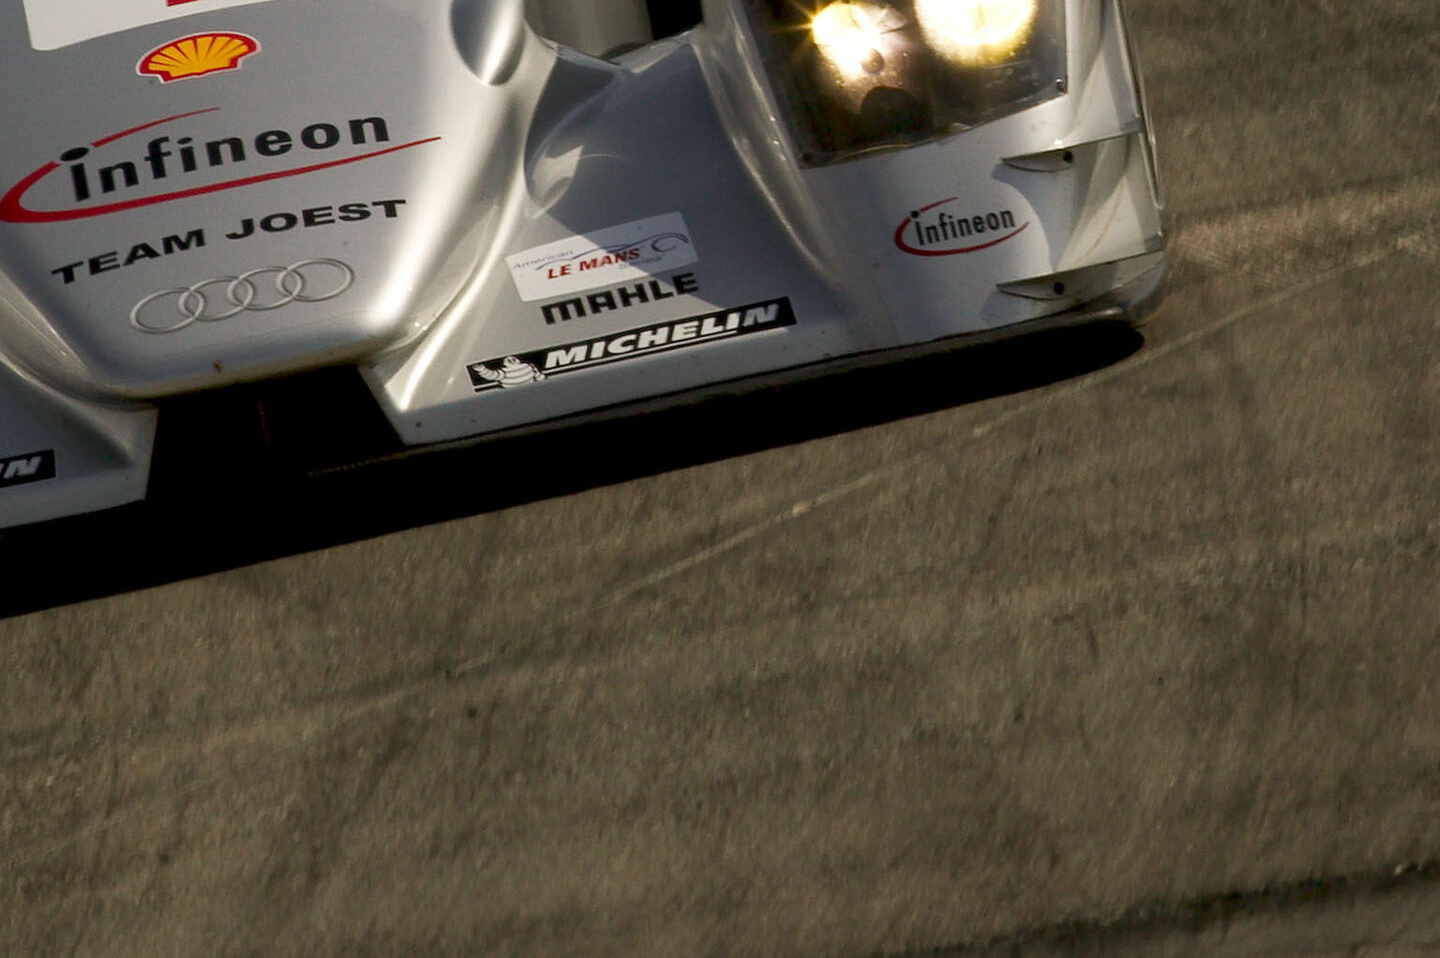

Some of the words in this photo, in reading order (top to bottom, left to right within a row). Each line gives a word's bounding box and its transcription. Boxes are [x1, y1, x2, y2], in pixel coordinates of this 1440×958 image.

[60, 114, 390, 202] infineon
[51, 229, 207, 285] TEAM
[226, 199, 407, 240] JOEST
[911, 205, 1016, 246] infineon
[547, 264, 572, 280] LE
[579, 247, 642, 272] MANS
[540, 272, 699, 326] MAHLE
[543, 304, 780, 369] MICHELIN
